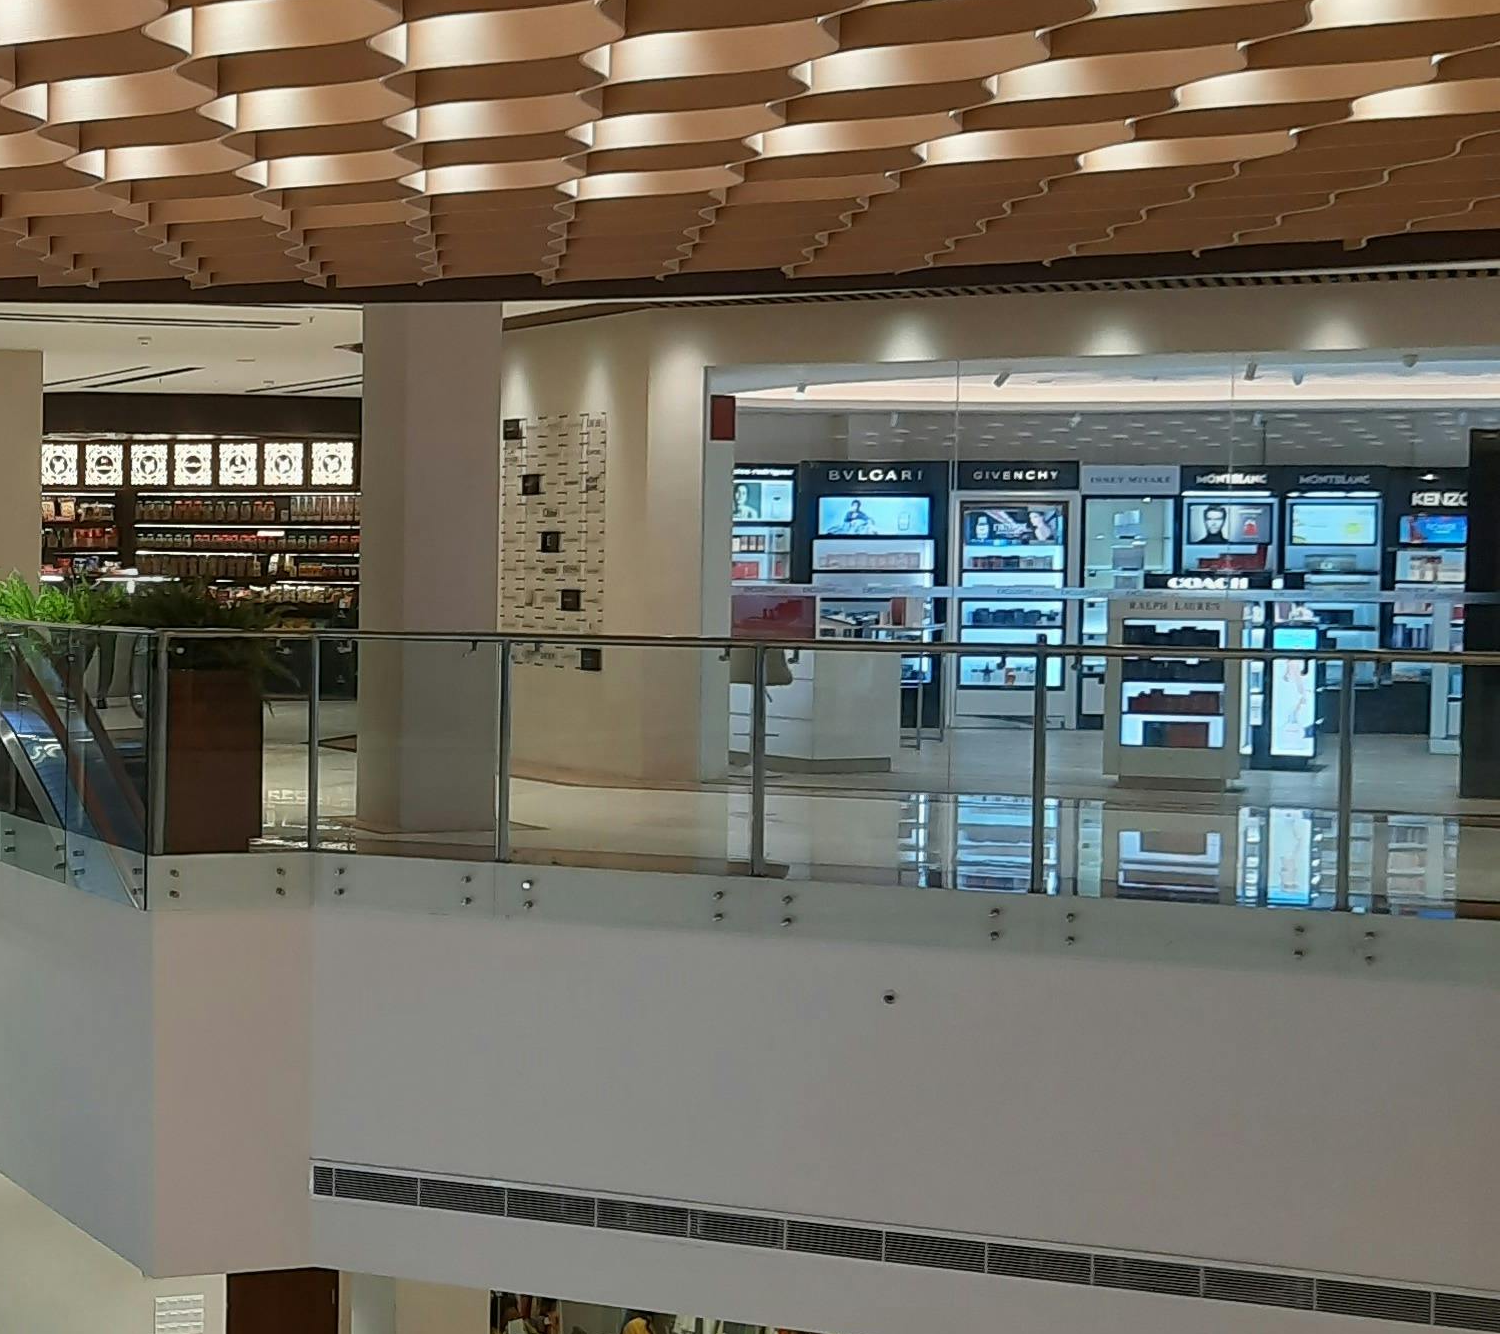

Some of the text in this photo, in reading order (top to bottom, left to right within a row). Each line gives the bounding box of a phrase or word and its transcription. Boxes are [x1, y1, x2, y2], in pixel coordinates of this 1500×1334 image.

[828, 469, 923, 482] BVLGARI
[973, 469, 1059, 482] GIVENCHY
[1167, 577, 1249, 590] COACH
